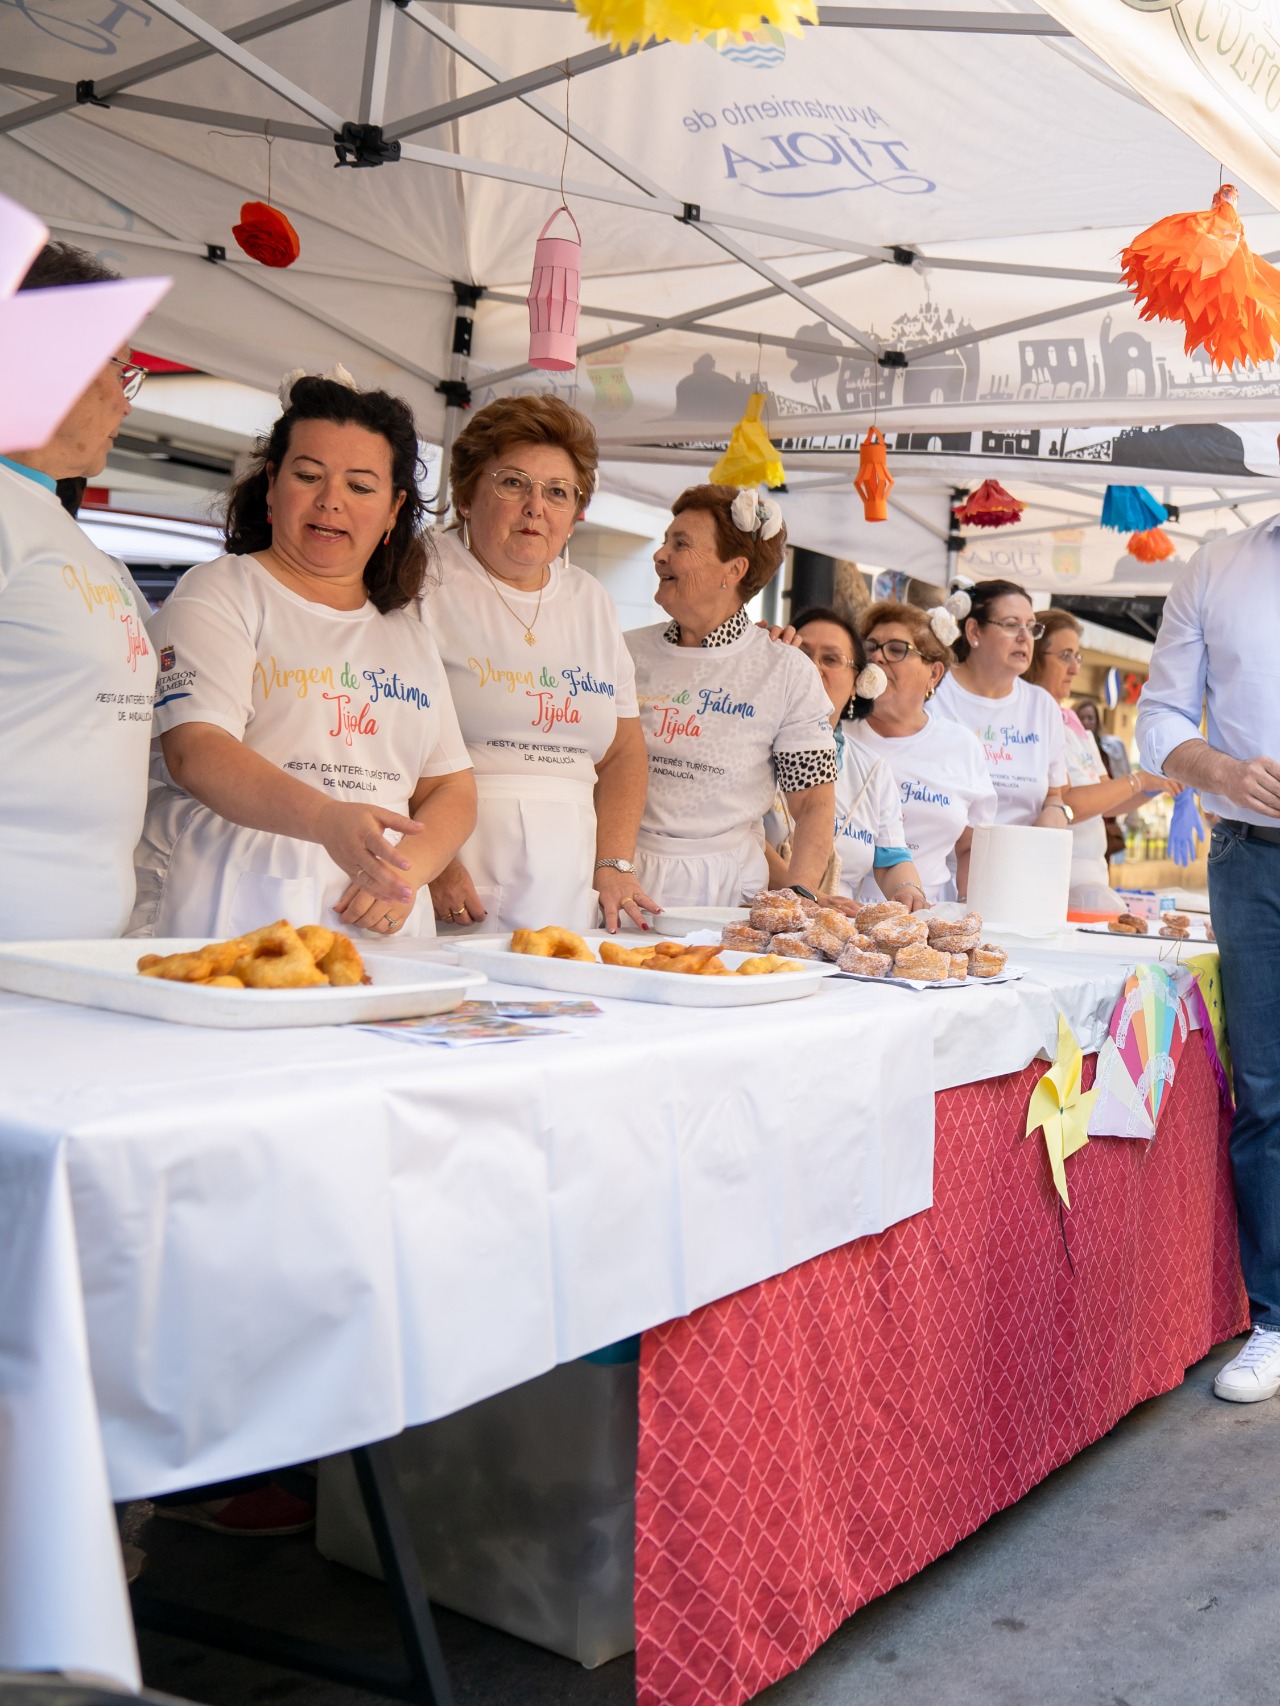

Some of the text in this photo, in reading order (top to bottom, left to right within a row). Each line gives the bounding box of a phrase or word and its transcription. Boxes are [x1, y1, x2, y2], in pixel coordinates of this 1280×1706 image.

[253, 656, 431, 710] Virgen de Fátima
[467, 657, 615, 699] Virgen de Fátima
[525, 690, 582, 733] Tíjola
[671, 689, 692, 705] de
[697, 688, 755, 719] Fátima
[321, 692, 379, 746] Tíjola
[653, 704, 702, 744] Tíjola
[486, 740, 516, 748] FIESTA
[518, 743, 529, 751] DE
[984, 724, 998, 741] de
[1000, 725, 1039, 747] Fátima
[321, 763, 332, 773] DE
[524, 754, 575, 765] DE ANDALUCÍA
[652, 755, 683, 767] INTERÉS
[685, 761, 725, 776] TURÍSTICO
[323, 778, 336, 788] DE
[652, 767, 694, 780] ANDALUCÍA
[900, 781, 950, 807] Fátima
